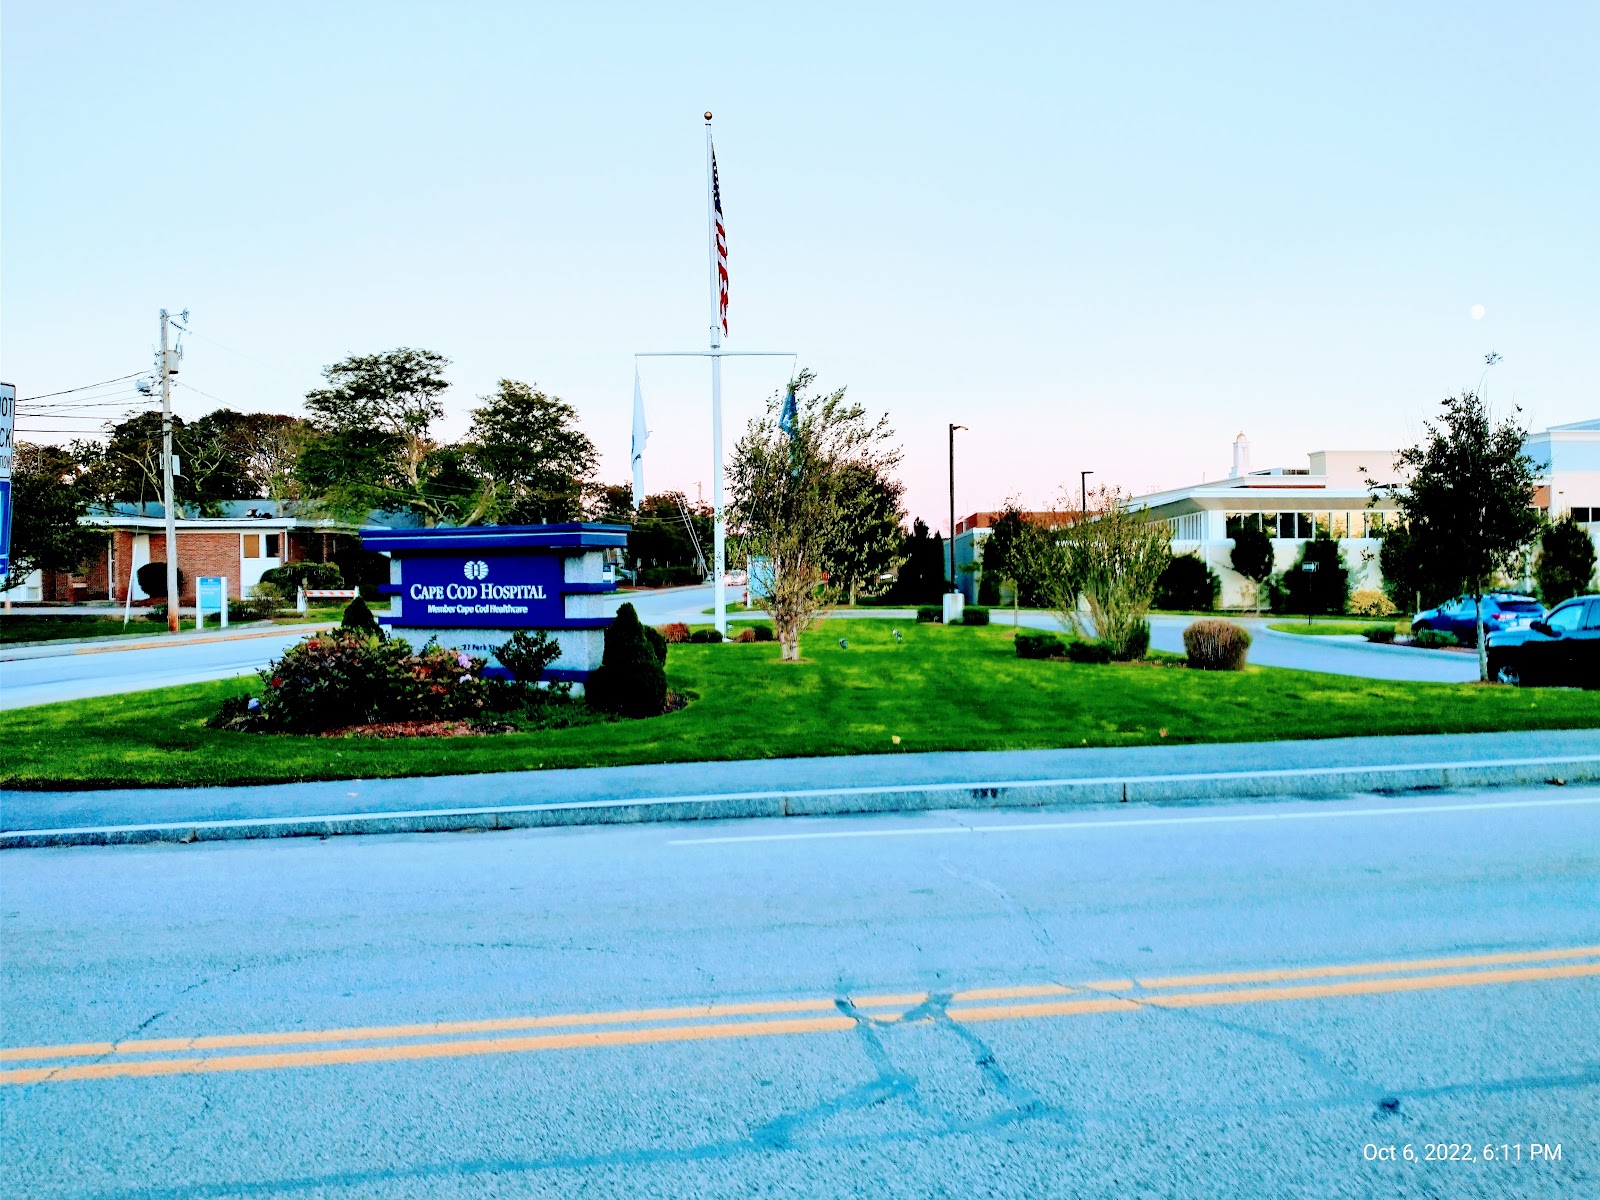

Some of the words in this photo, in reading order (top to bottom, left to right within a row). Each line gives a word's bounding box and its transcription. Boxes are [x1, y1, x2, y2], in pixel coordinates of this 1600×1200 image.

[0, 396, 13, 417] OT
[410, 583, 444, 600] CAPE
[446, 583, 478, 600] COD
[480, 583, 547, 599] HOSPITAL
[428, 604, 456, 613] Member
[457, 604, 474, 615] Cape
[475, 604, 489, 613] Cod
[490, 604, 528, 613] Healthcare
